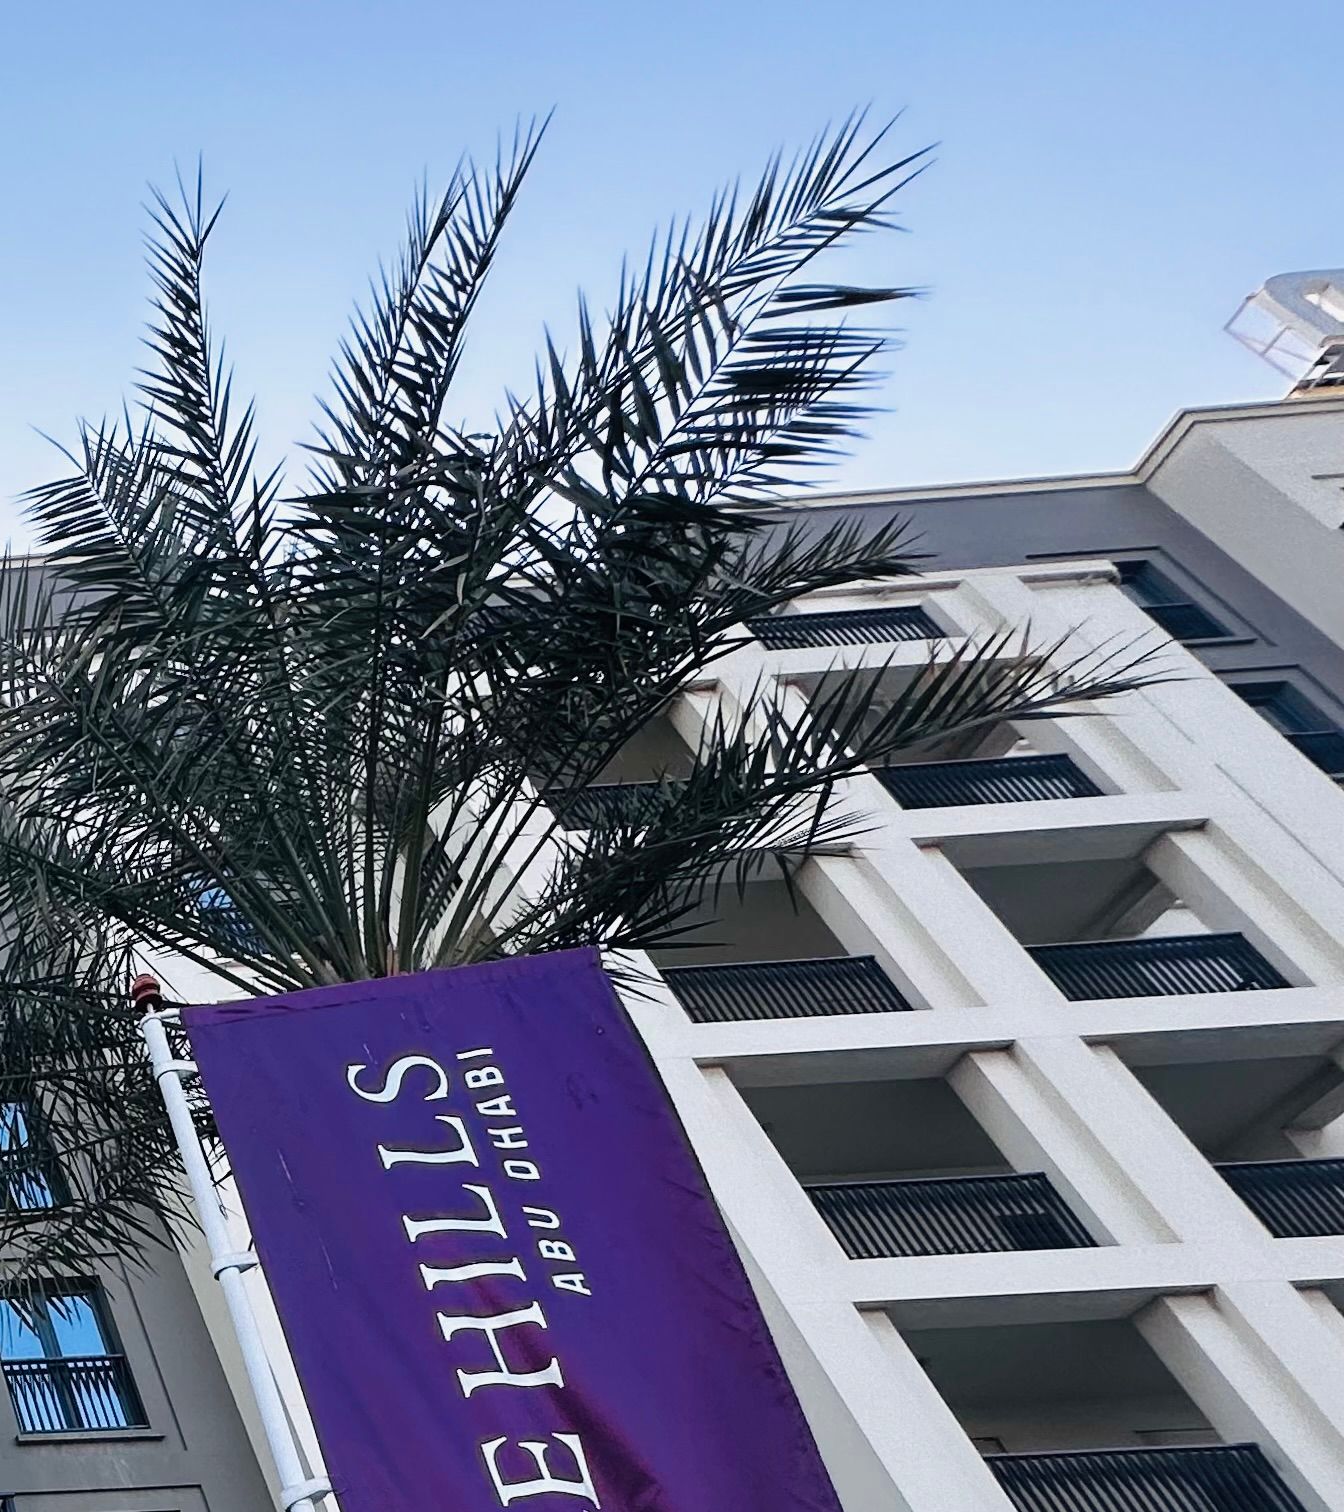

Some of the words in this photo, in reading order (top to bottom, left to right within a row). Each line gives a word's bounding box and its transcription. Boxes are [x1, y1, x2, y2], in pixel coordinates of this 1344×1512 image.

[456, 1048, 541, 1180] DHABI
[346, 1055, 564, 1398] HILLS
[521, 1206, 592, 1295] ABU
